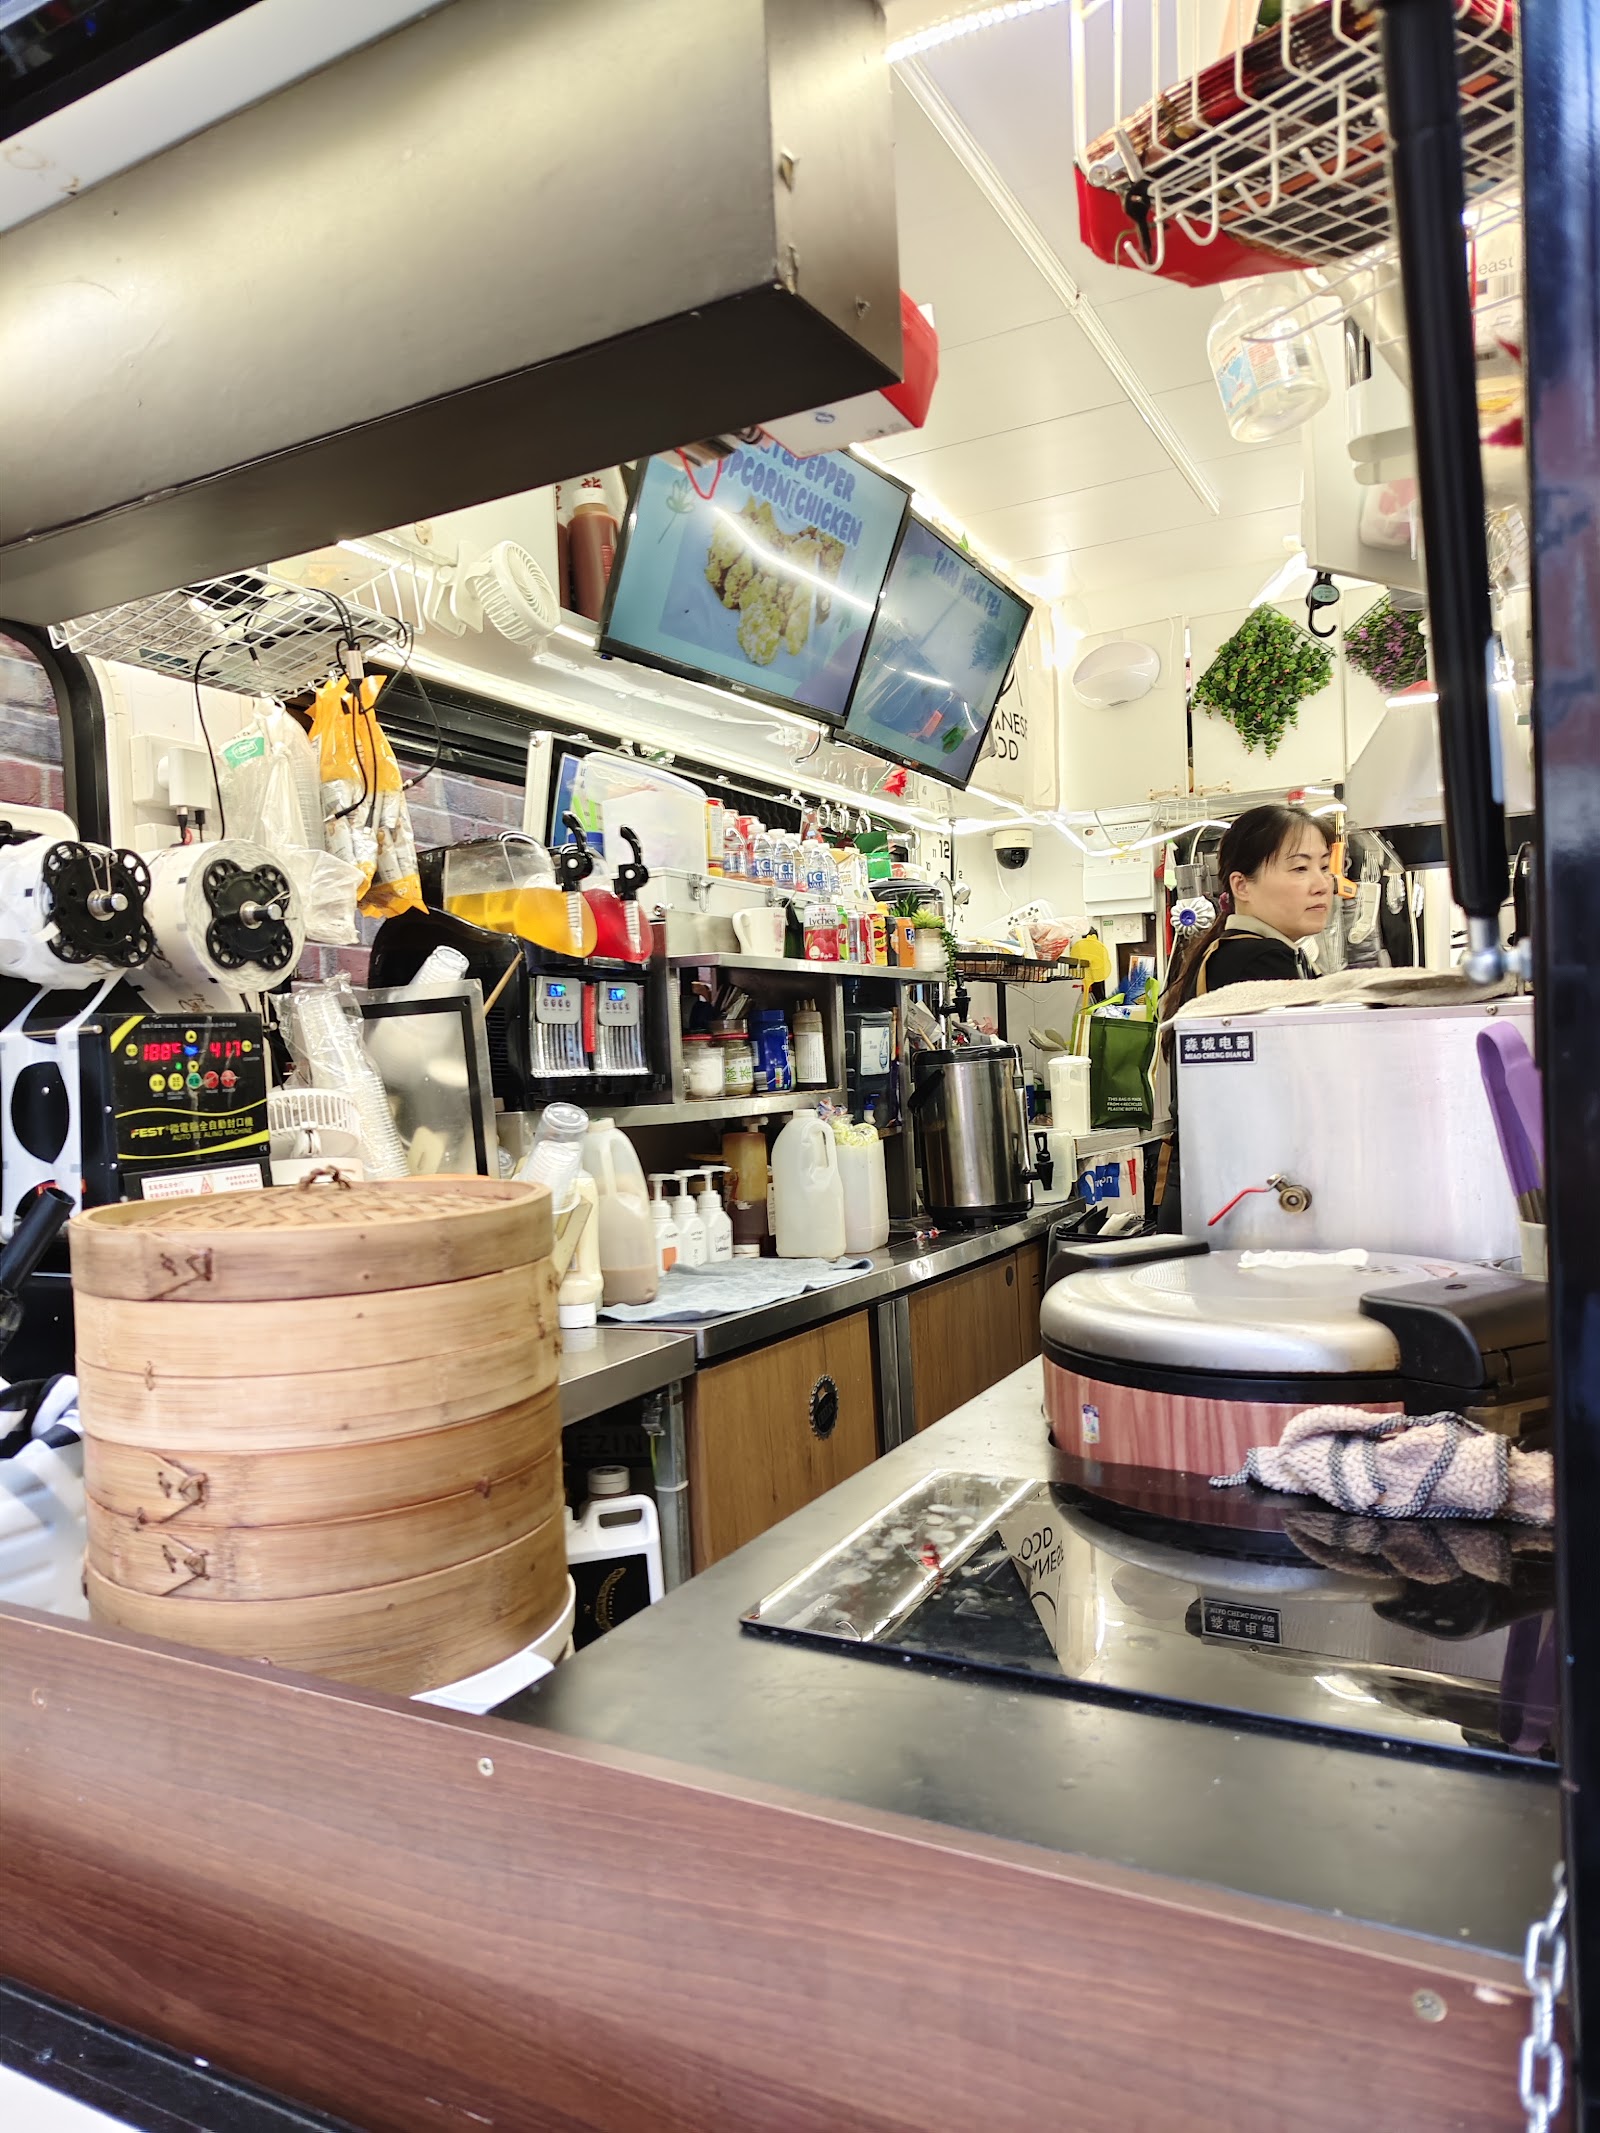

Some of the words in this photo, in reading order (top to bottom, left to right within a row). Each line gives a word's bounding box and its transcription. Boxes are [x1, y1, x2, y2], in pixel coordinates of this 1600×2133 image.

[794, 487, 863, 546] CHICKEN
[939, 840, 950, 859] 12
[809, 915, 836, 927] Lychee
[1225, 1051, 1241, 1059] DIAN
[1242, 1050, 1251, 1059] QI
[225, 1127, 253, 1136] MACHINE
